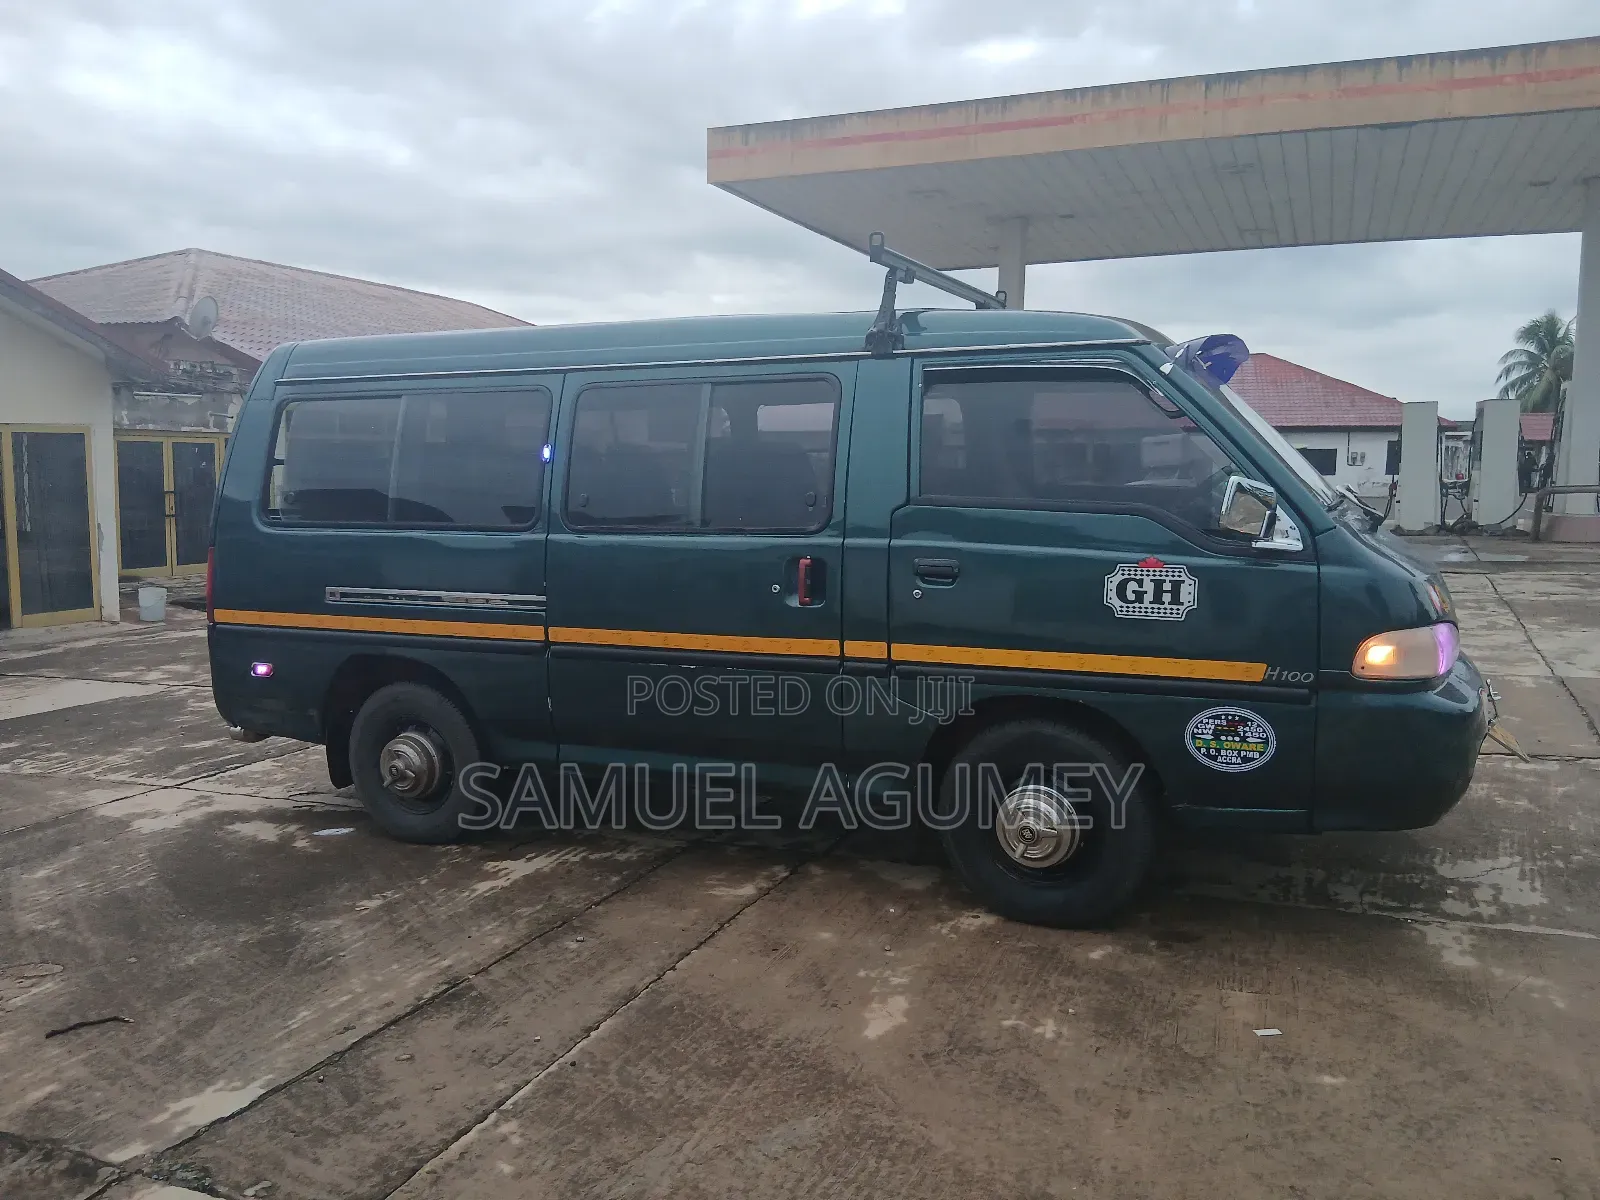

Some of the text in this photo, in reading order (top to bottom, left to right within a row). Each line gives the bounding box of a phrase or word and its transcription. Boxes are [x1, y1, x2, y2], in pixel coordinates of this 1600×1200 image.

[1115, 577, 1186, 606] GH
[1264, 667, 1314, 682] H100
[1223, 742, 1264, 751] OWARE
